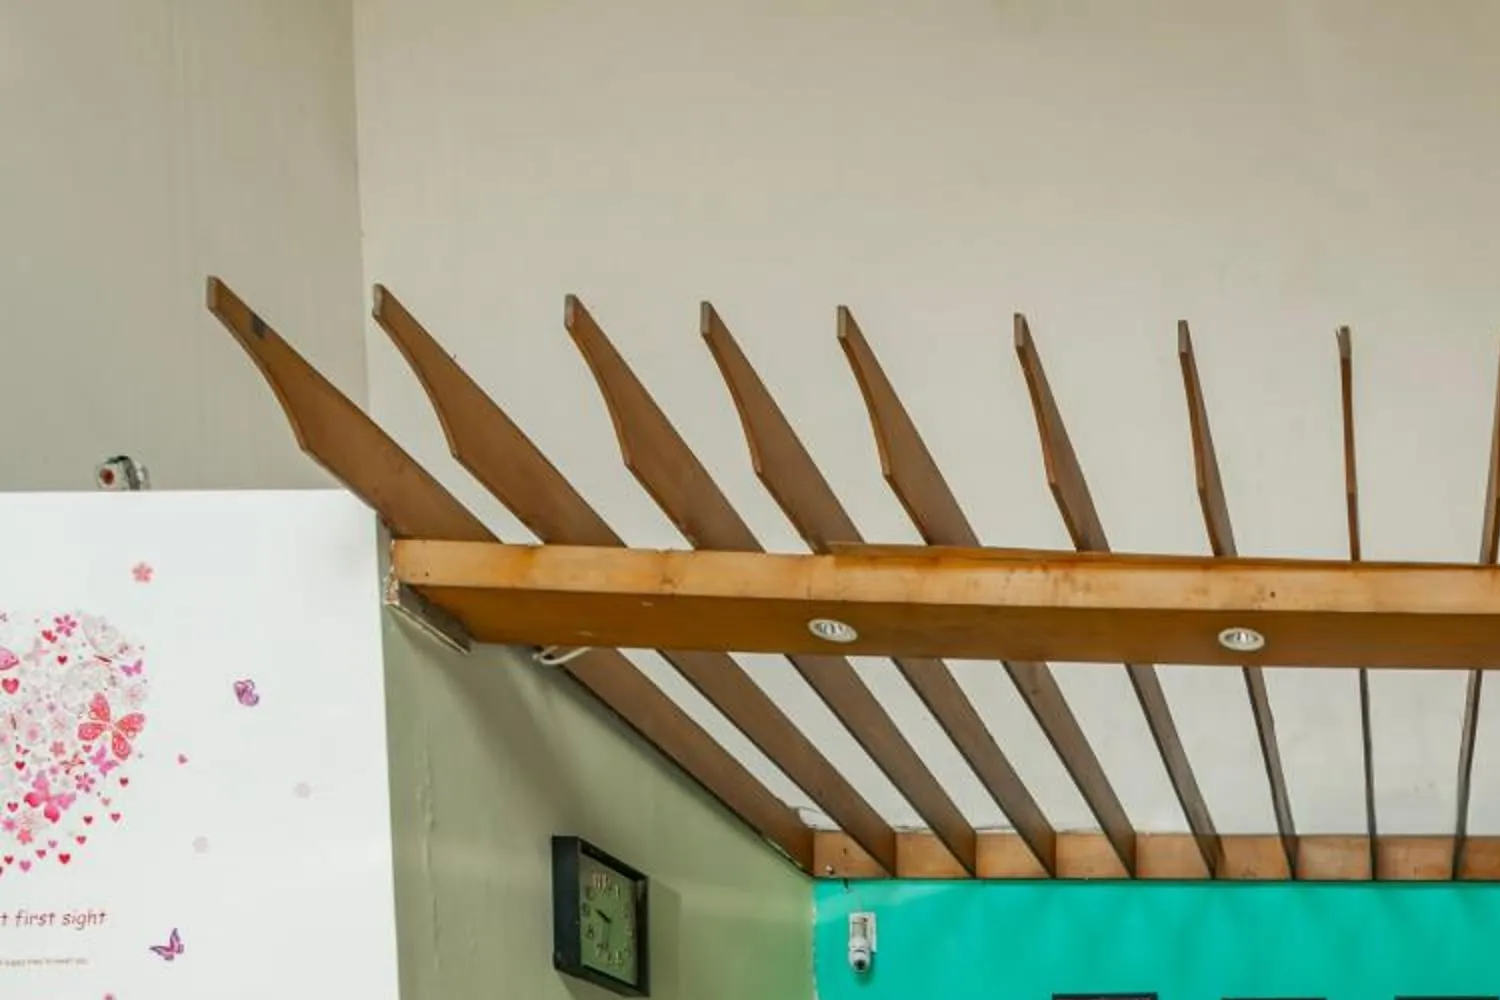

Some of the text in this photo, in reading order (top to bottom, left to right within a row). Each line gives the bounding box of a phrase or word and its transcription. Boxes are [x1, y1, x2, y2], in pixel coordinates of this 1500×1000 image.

[0, 909, 107, 931] t first sight
